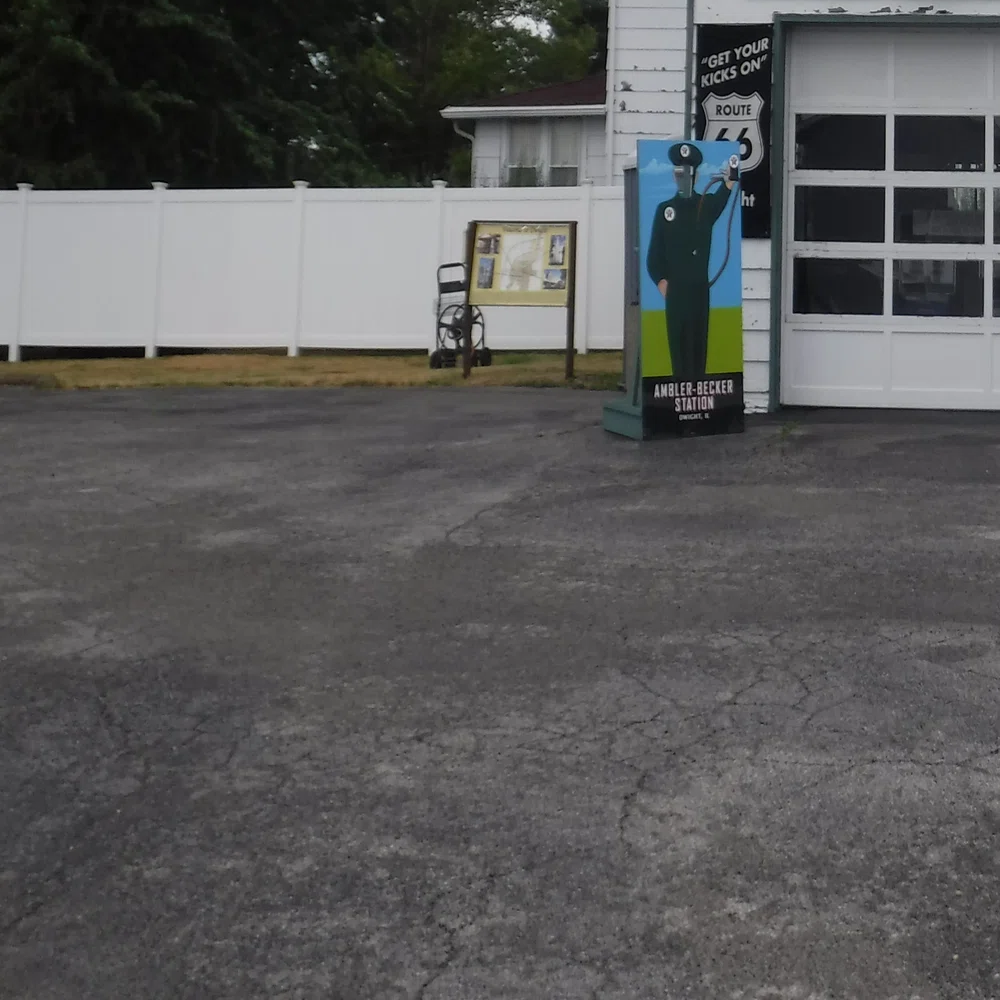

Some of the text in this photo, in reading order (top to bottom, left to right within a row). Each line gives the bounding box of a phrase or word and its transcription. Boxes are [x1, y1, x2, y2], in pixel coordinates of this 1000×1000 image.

[734, 37, 769, 61] YOUR
[701, 65, 737, 88] KICKS
[715, 104, 752, 116] ROUTE
[653, 380, 733, 398] AMBLER-BECKER
[675, 396, 714, 412] STATION
